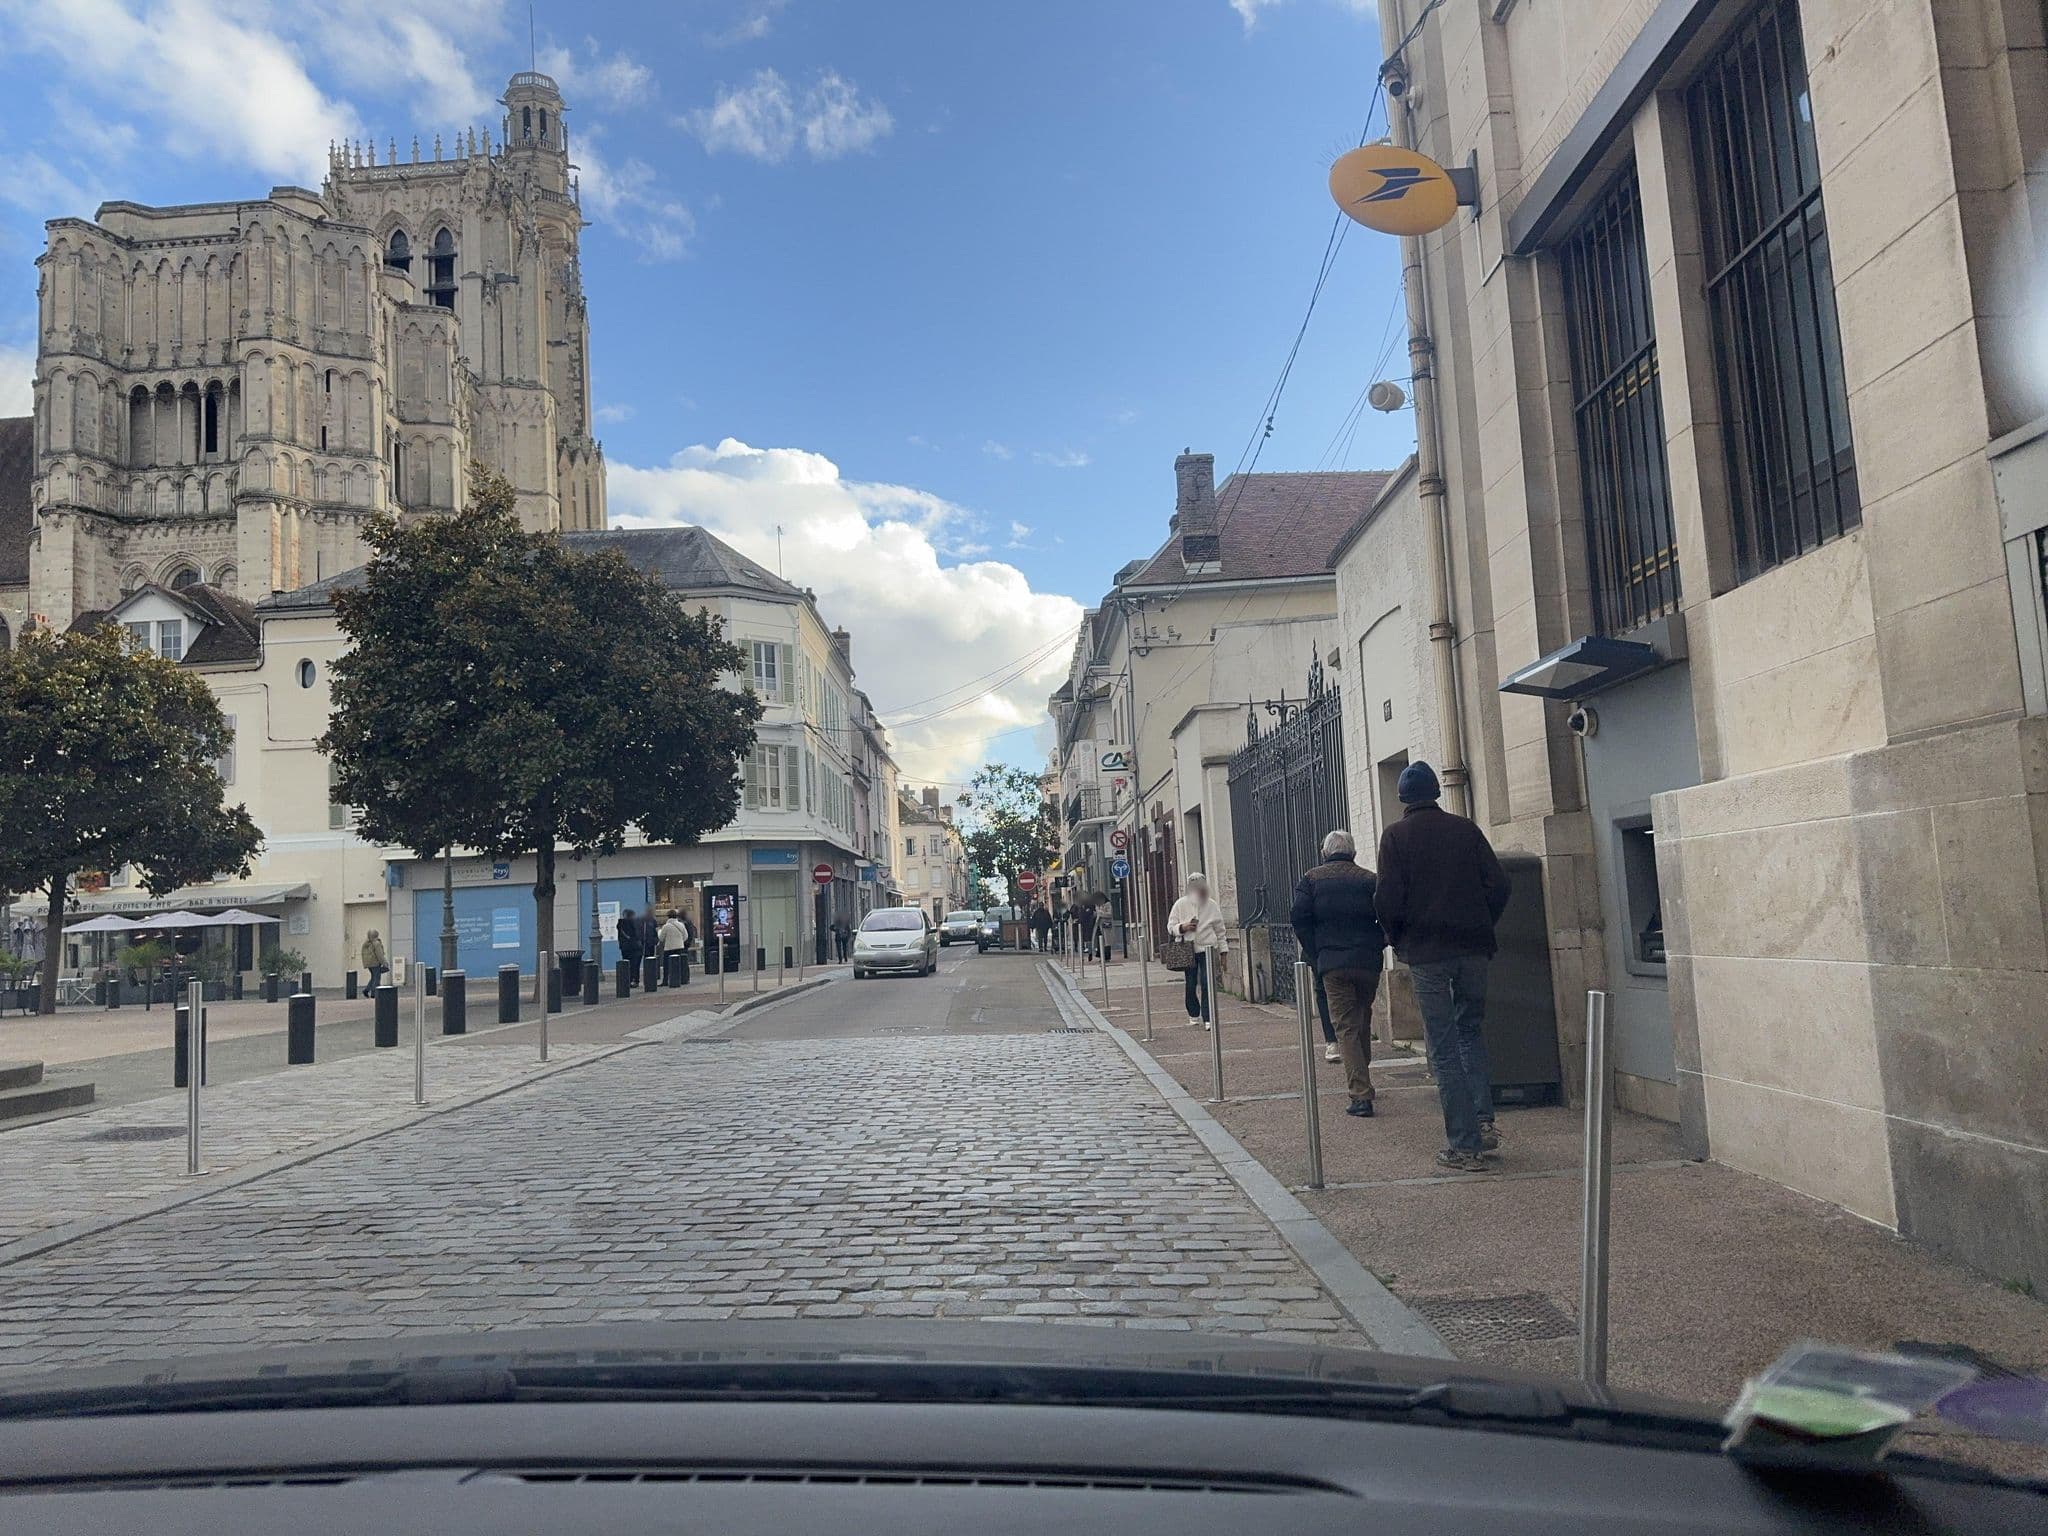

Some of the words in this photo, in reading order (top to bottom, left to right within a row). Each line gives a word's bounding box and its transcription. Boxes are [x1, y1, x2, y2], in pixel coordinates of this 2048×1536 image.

[1101, 752, 1129, 768] CA
[493, 867, 507, 877] Krys
[143, 901, 153, 909] DE
[156, 900, 172, 909] MER
[189, 899, 204, 907] BAR
